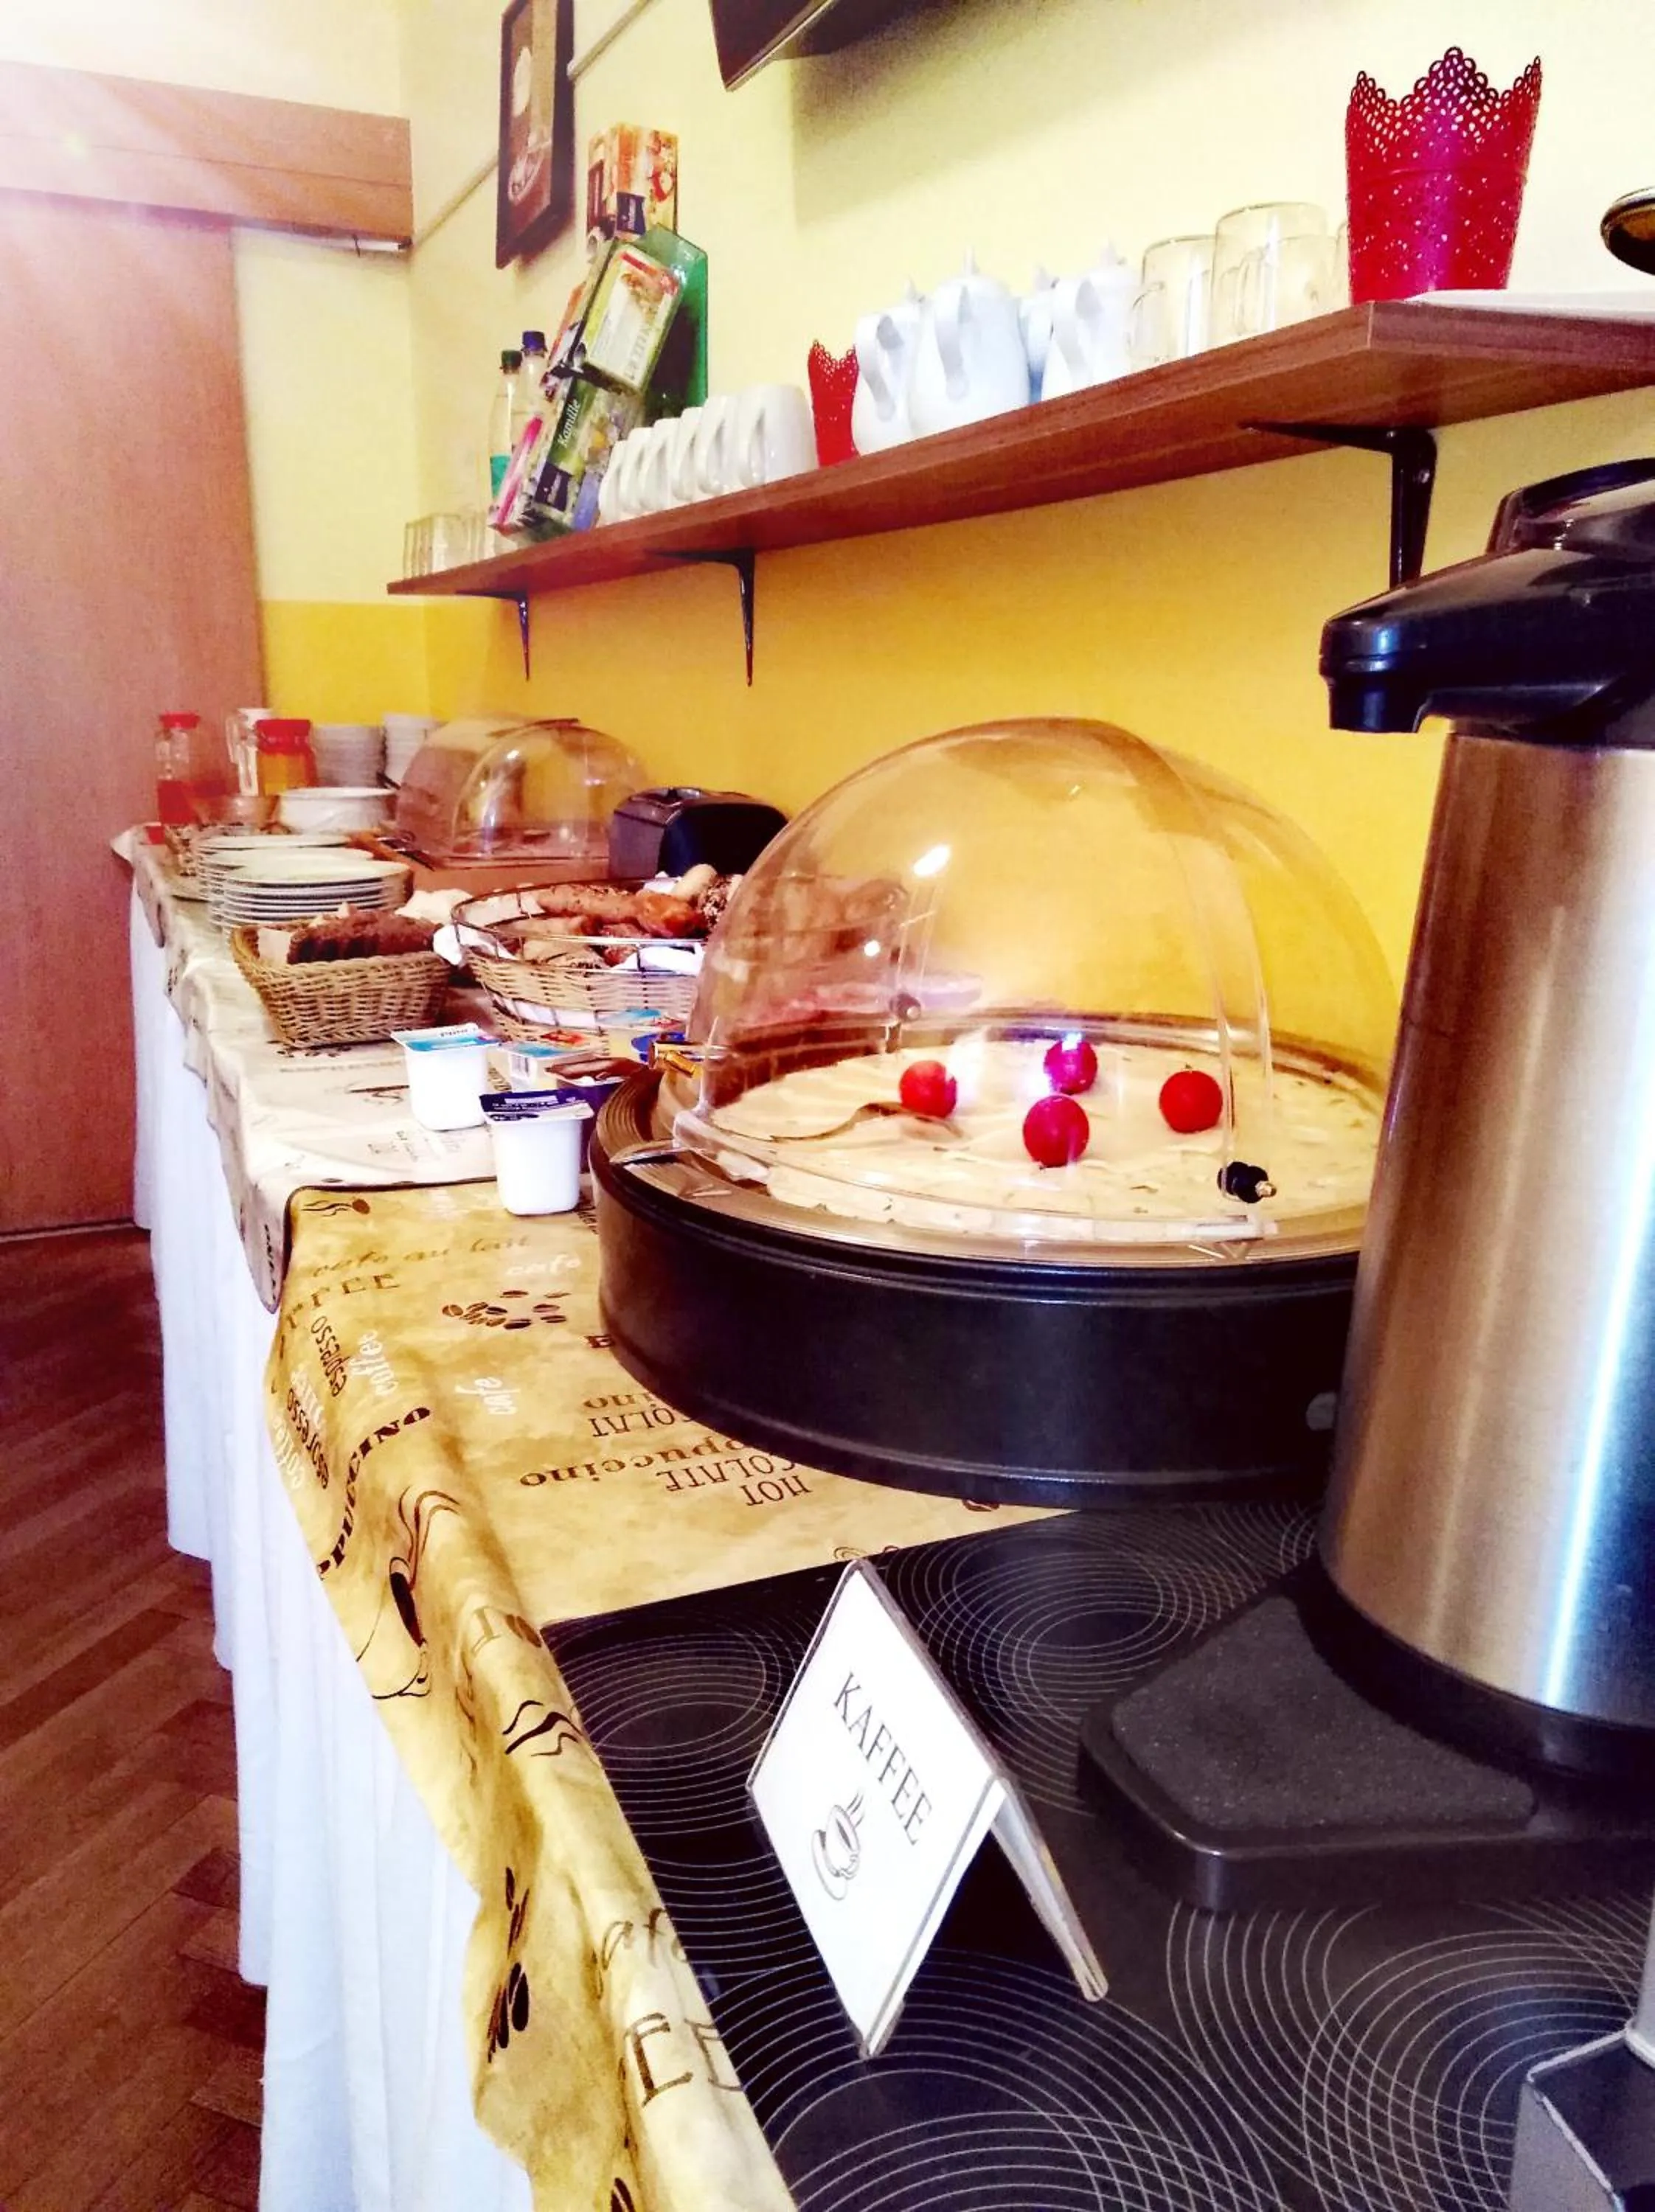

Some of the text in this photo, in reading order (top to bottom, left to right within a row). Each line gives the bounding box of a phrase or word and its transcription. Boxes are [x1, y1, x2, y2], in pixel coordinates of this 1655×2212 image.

[557, 399, 581, 448] Kamille
[310, 1315, 352, 1397] espresso
[740, 1475, 813, 1507] HOT
[833, 1672, 933, 1846] KAFFEE
